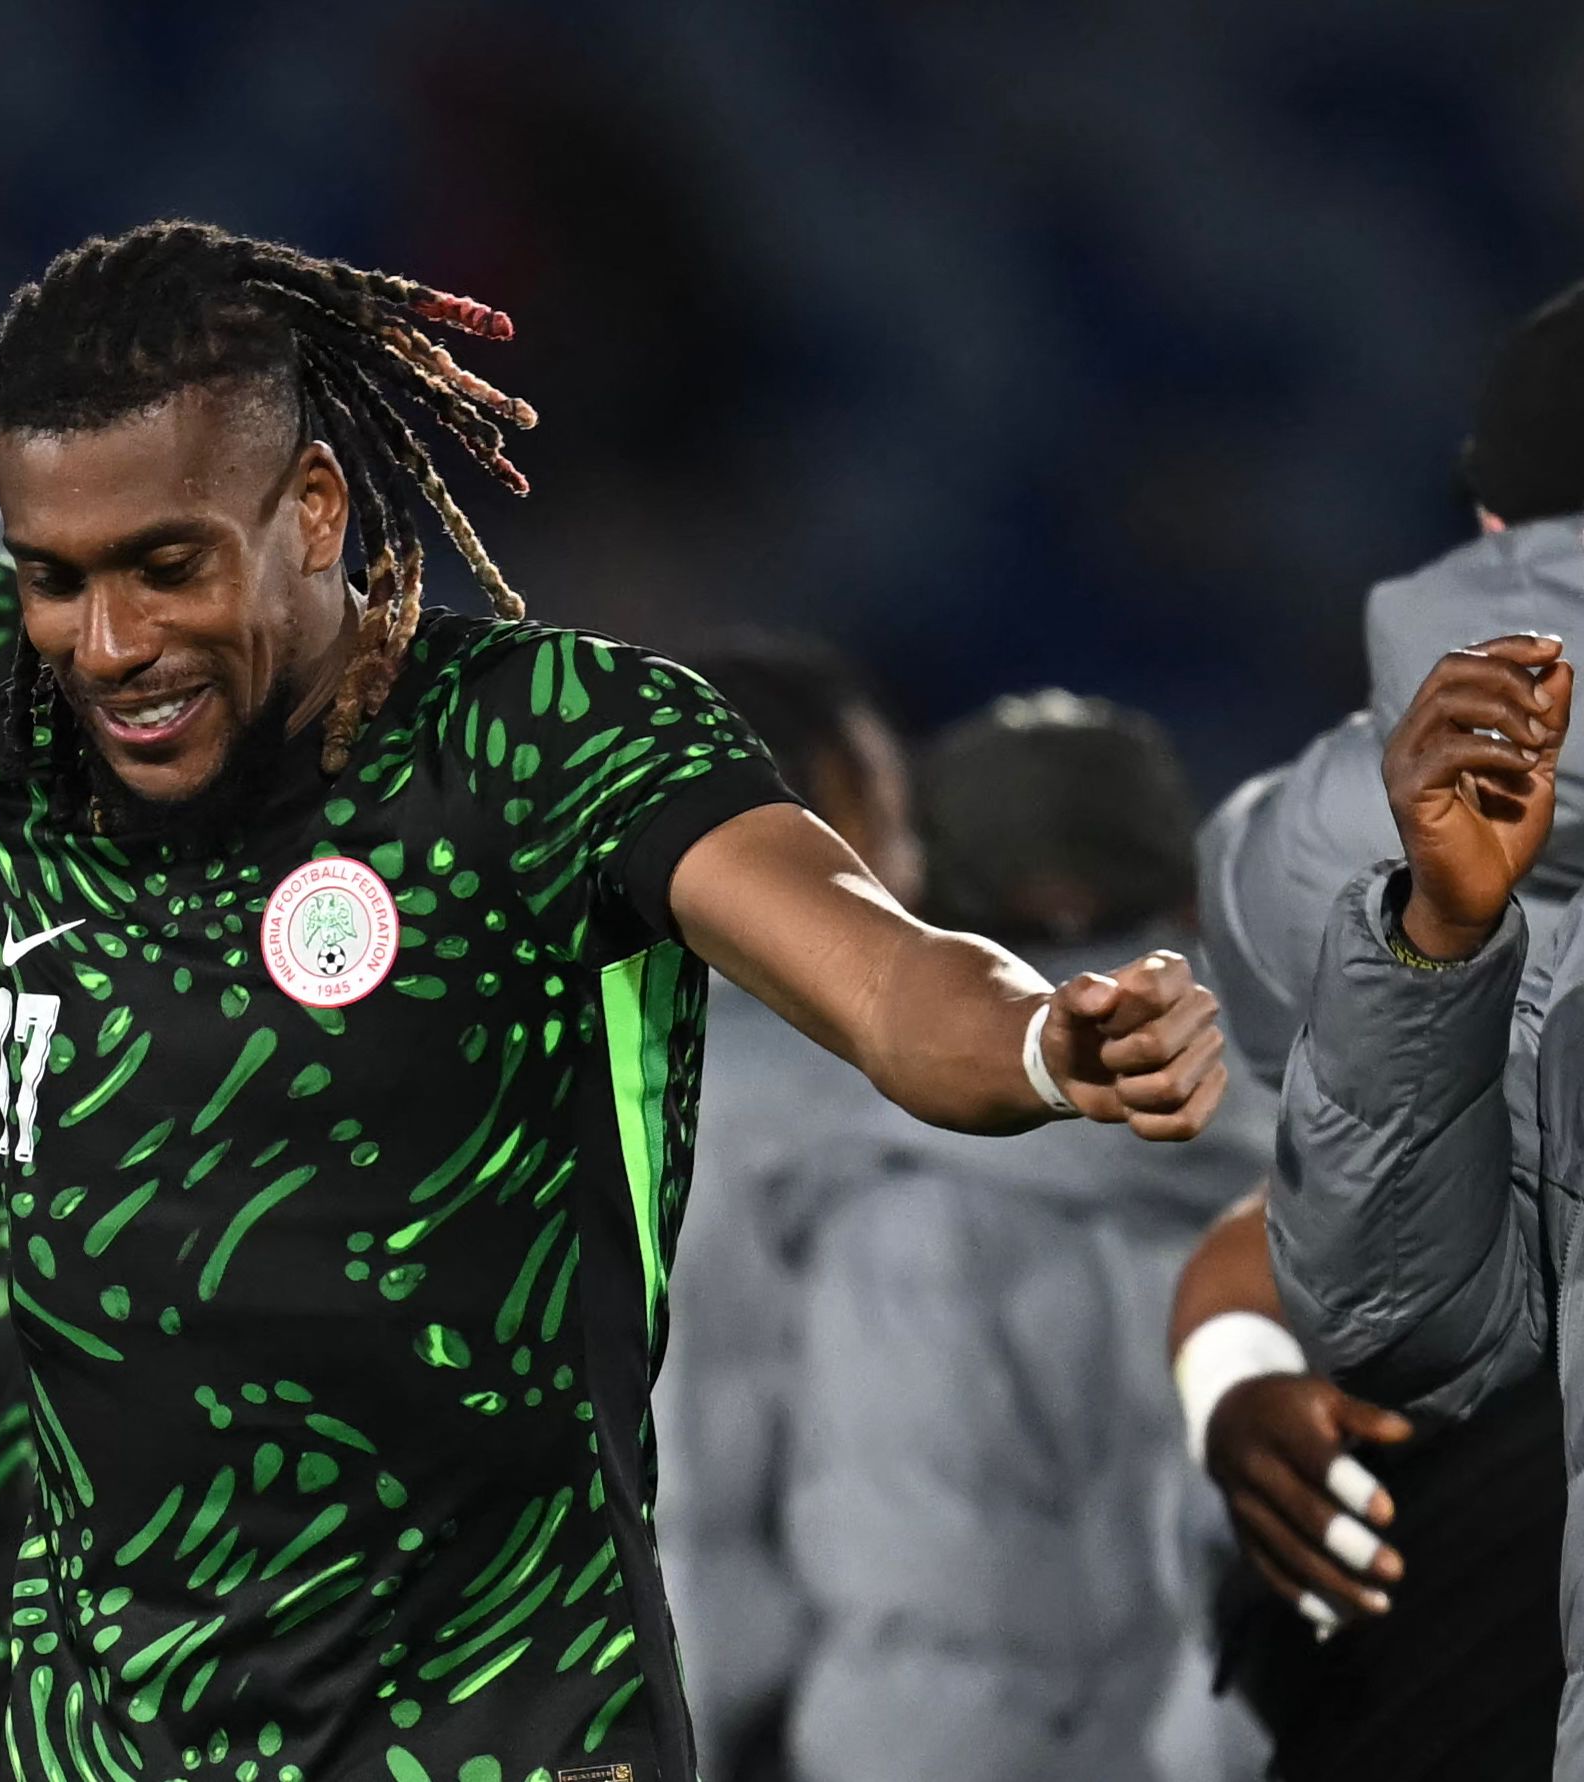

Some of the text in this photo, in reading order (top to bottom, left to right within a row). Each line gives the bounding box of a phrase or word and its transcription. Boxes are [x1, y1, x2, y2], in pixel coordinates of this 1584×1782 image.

[269, 866, 390, 982] NIGERIA FOOTBALL FEDERATION
[318, 980, 351, 997] 1945
